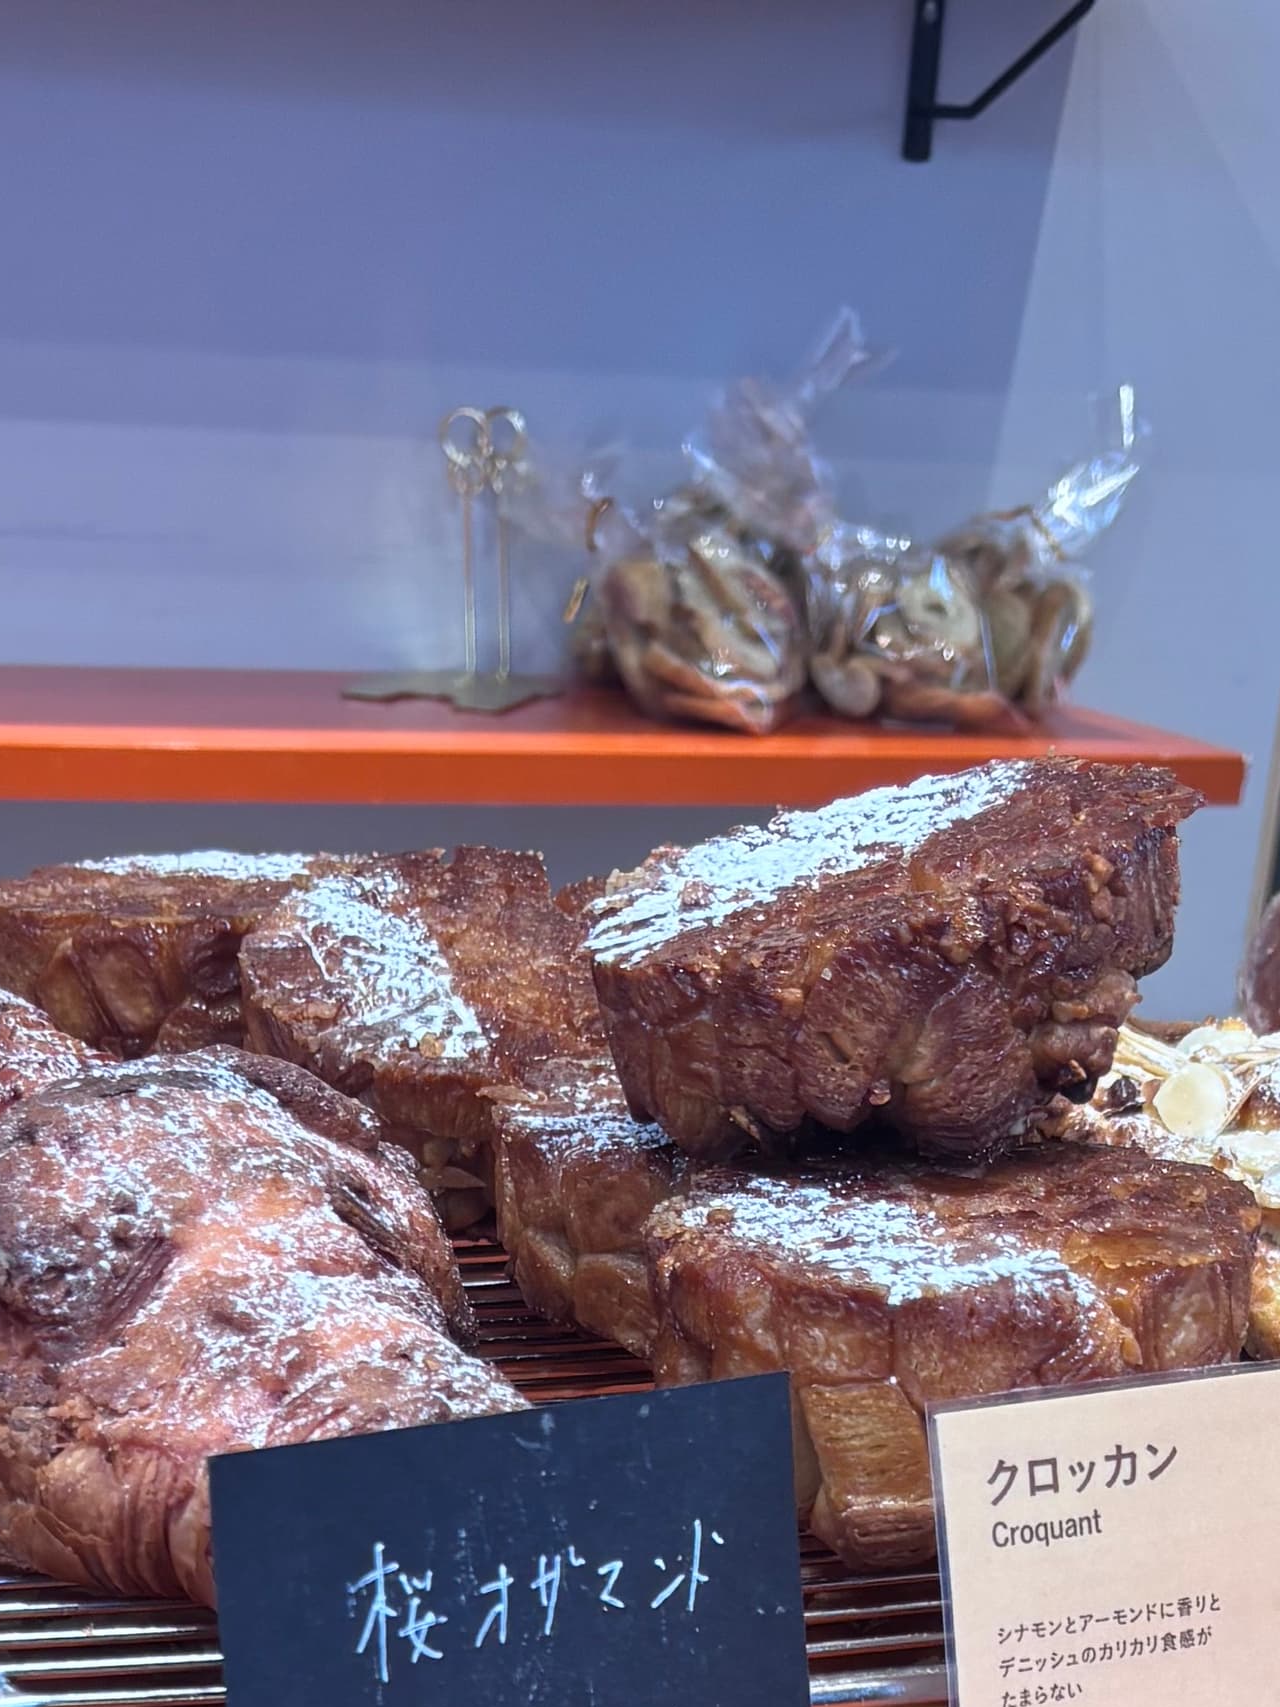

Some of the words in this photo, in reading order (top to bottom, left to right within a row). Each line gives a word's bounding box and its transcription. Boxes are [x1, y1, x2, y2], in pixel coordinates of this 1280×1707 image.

[986, 1441, 1179, 1507] クロッカン
[991, 1509, 1103, 1548] Croquant
[997, 1593, 1222, 1645] シナモンとアーモンドに香りと
[999, 1626, 1213, 1678] デニッシュのカリカリ食感が
